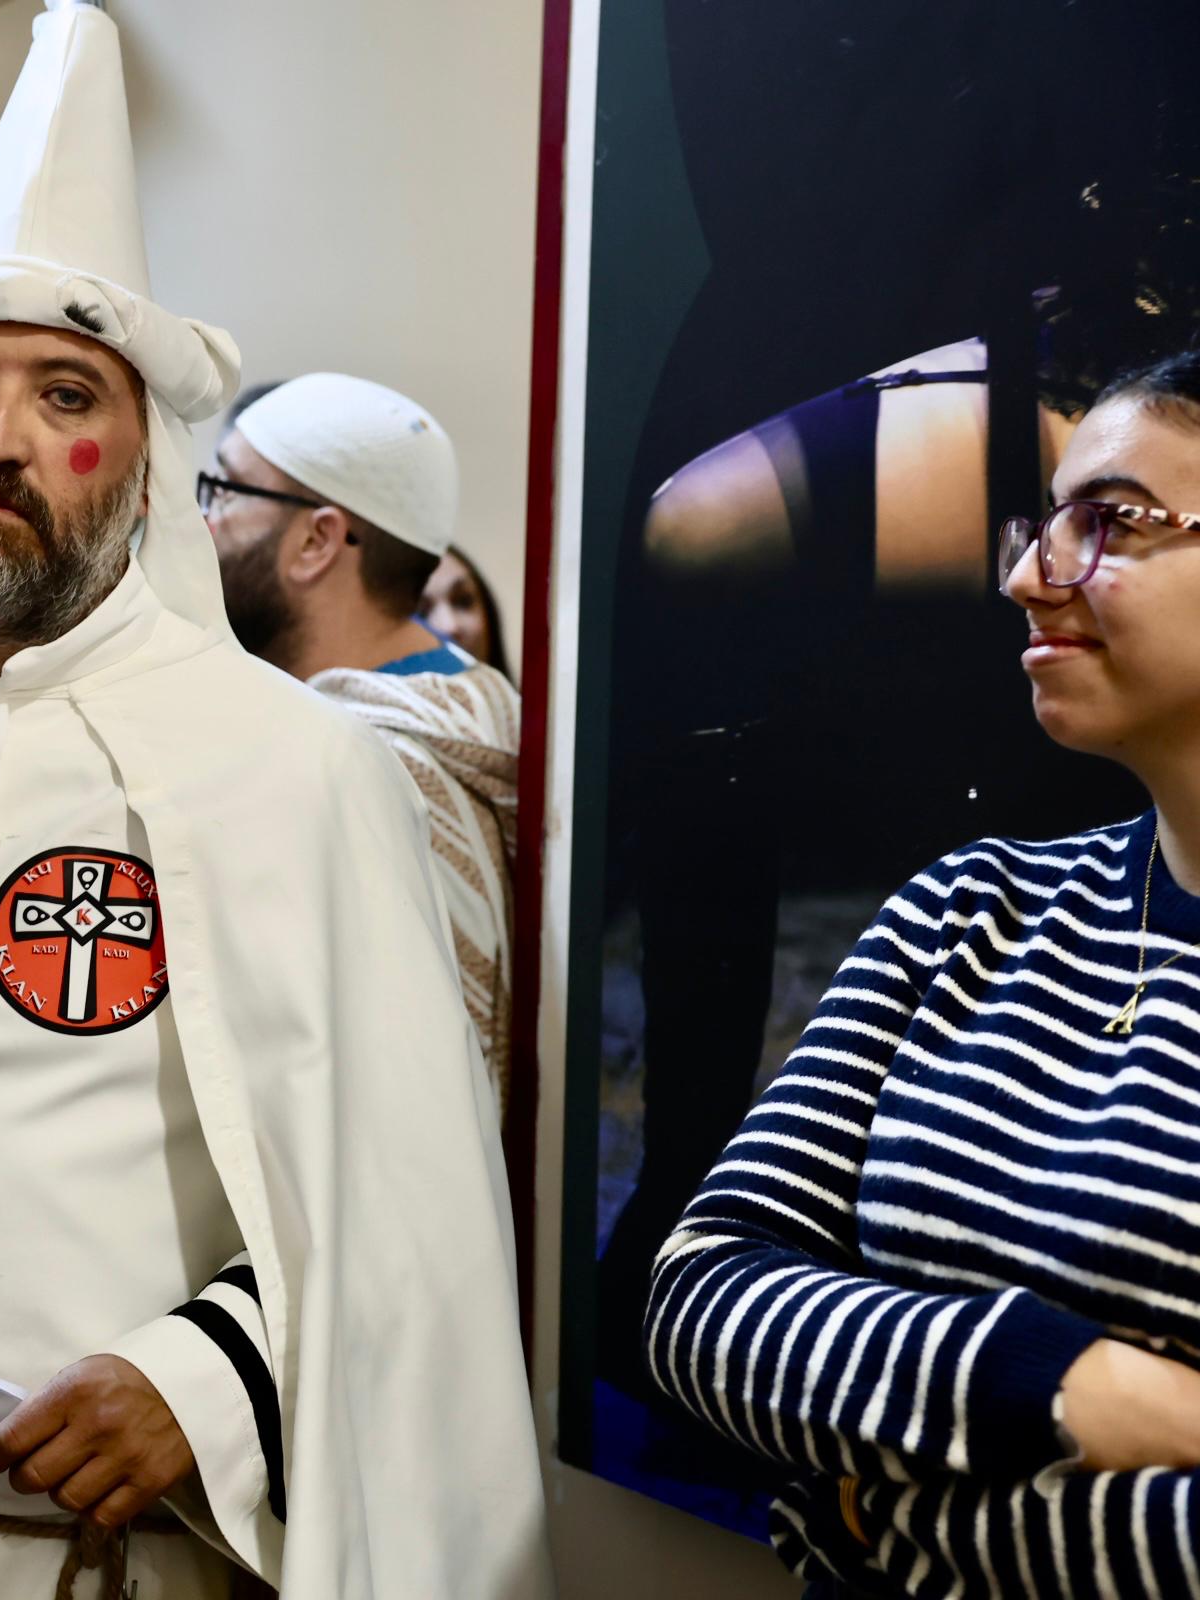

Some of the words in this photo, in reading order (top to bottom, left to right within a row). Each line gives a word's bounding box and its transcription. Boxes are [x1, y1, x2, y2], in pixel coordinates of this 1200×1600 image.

[22, 861, 53, 885] KU
[117, 861, 158, 898] KLUX
[75, 908, 93, 925] K
[32, 944, 59, 954] KADI
[103, 947, 130, 959] KADI
[109, 960, 167, 1020] KLAN
